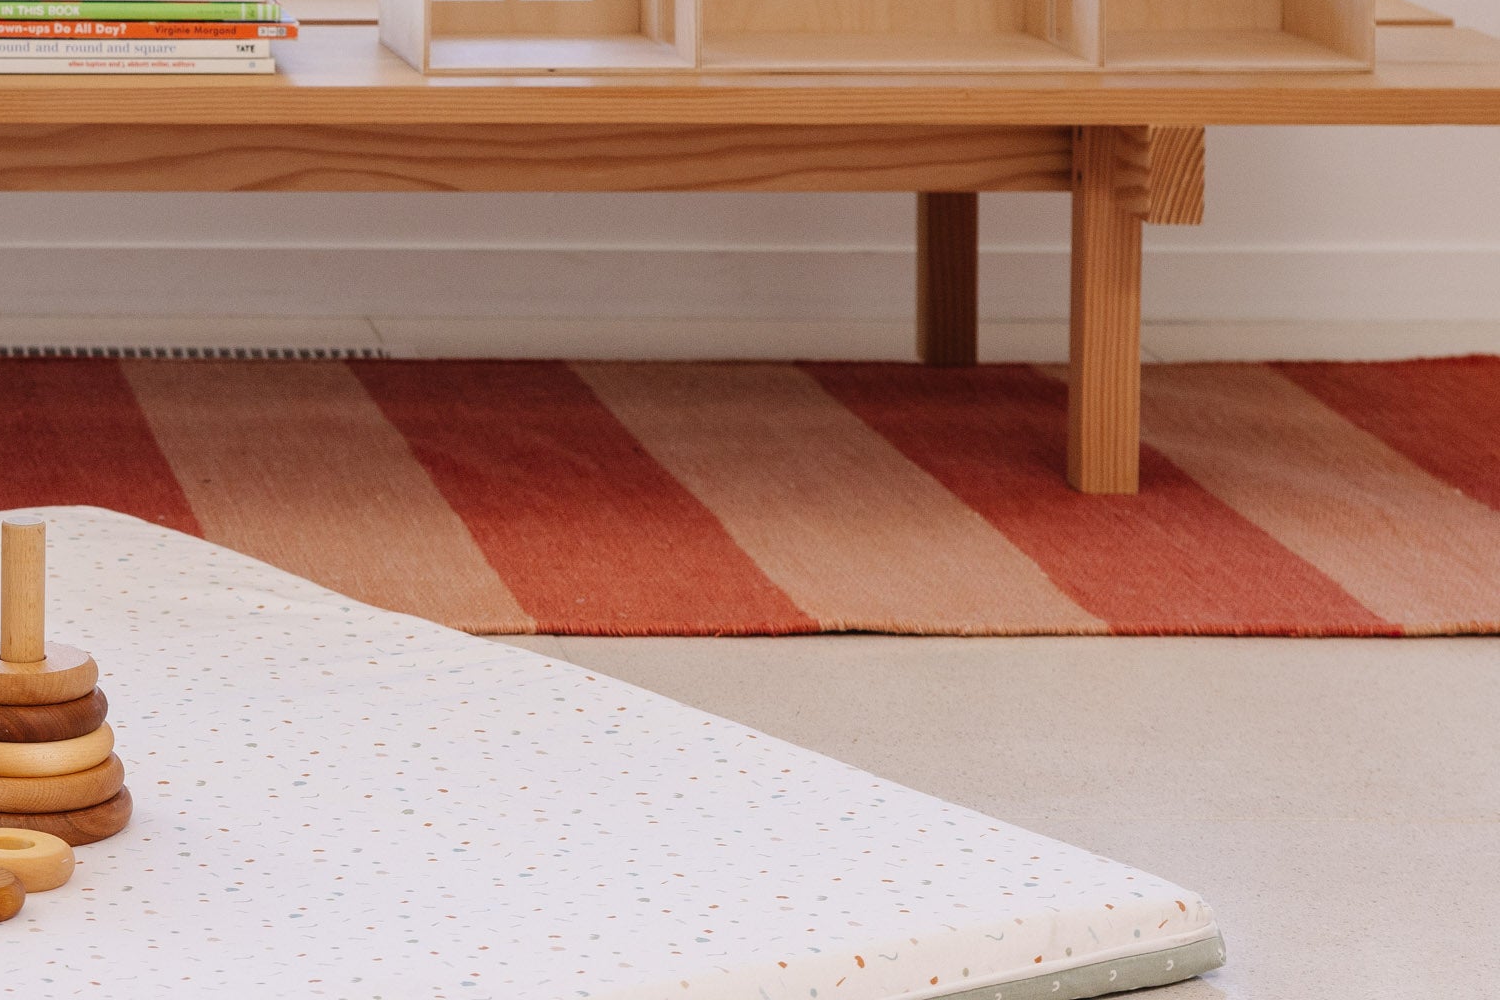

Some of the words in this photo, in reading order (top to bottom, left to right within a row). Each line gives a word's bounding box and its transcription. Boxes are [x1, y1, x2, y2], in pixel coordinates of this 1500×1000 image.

[1, 5, 14, 15] IN
[18, 5, 44, 15] THIS
[48, 5, 80, 16] BOOK
[53, 22, 71, 34] Do
[74, 22, 92, 34] All
[95, 23, 127, 36] Day?
[154, 26, 190, 36] Virginie
[193, 26, 236, 36] Morgand
[35, 42, 58, 52] and
[66, 43, 102, 52] round
[107, 43, 130, 53] and
[134, 45, 176, 55] square
[236, 44, 256, 53] TATE
